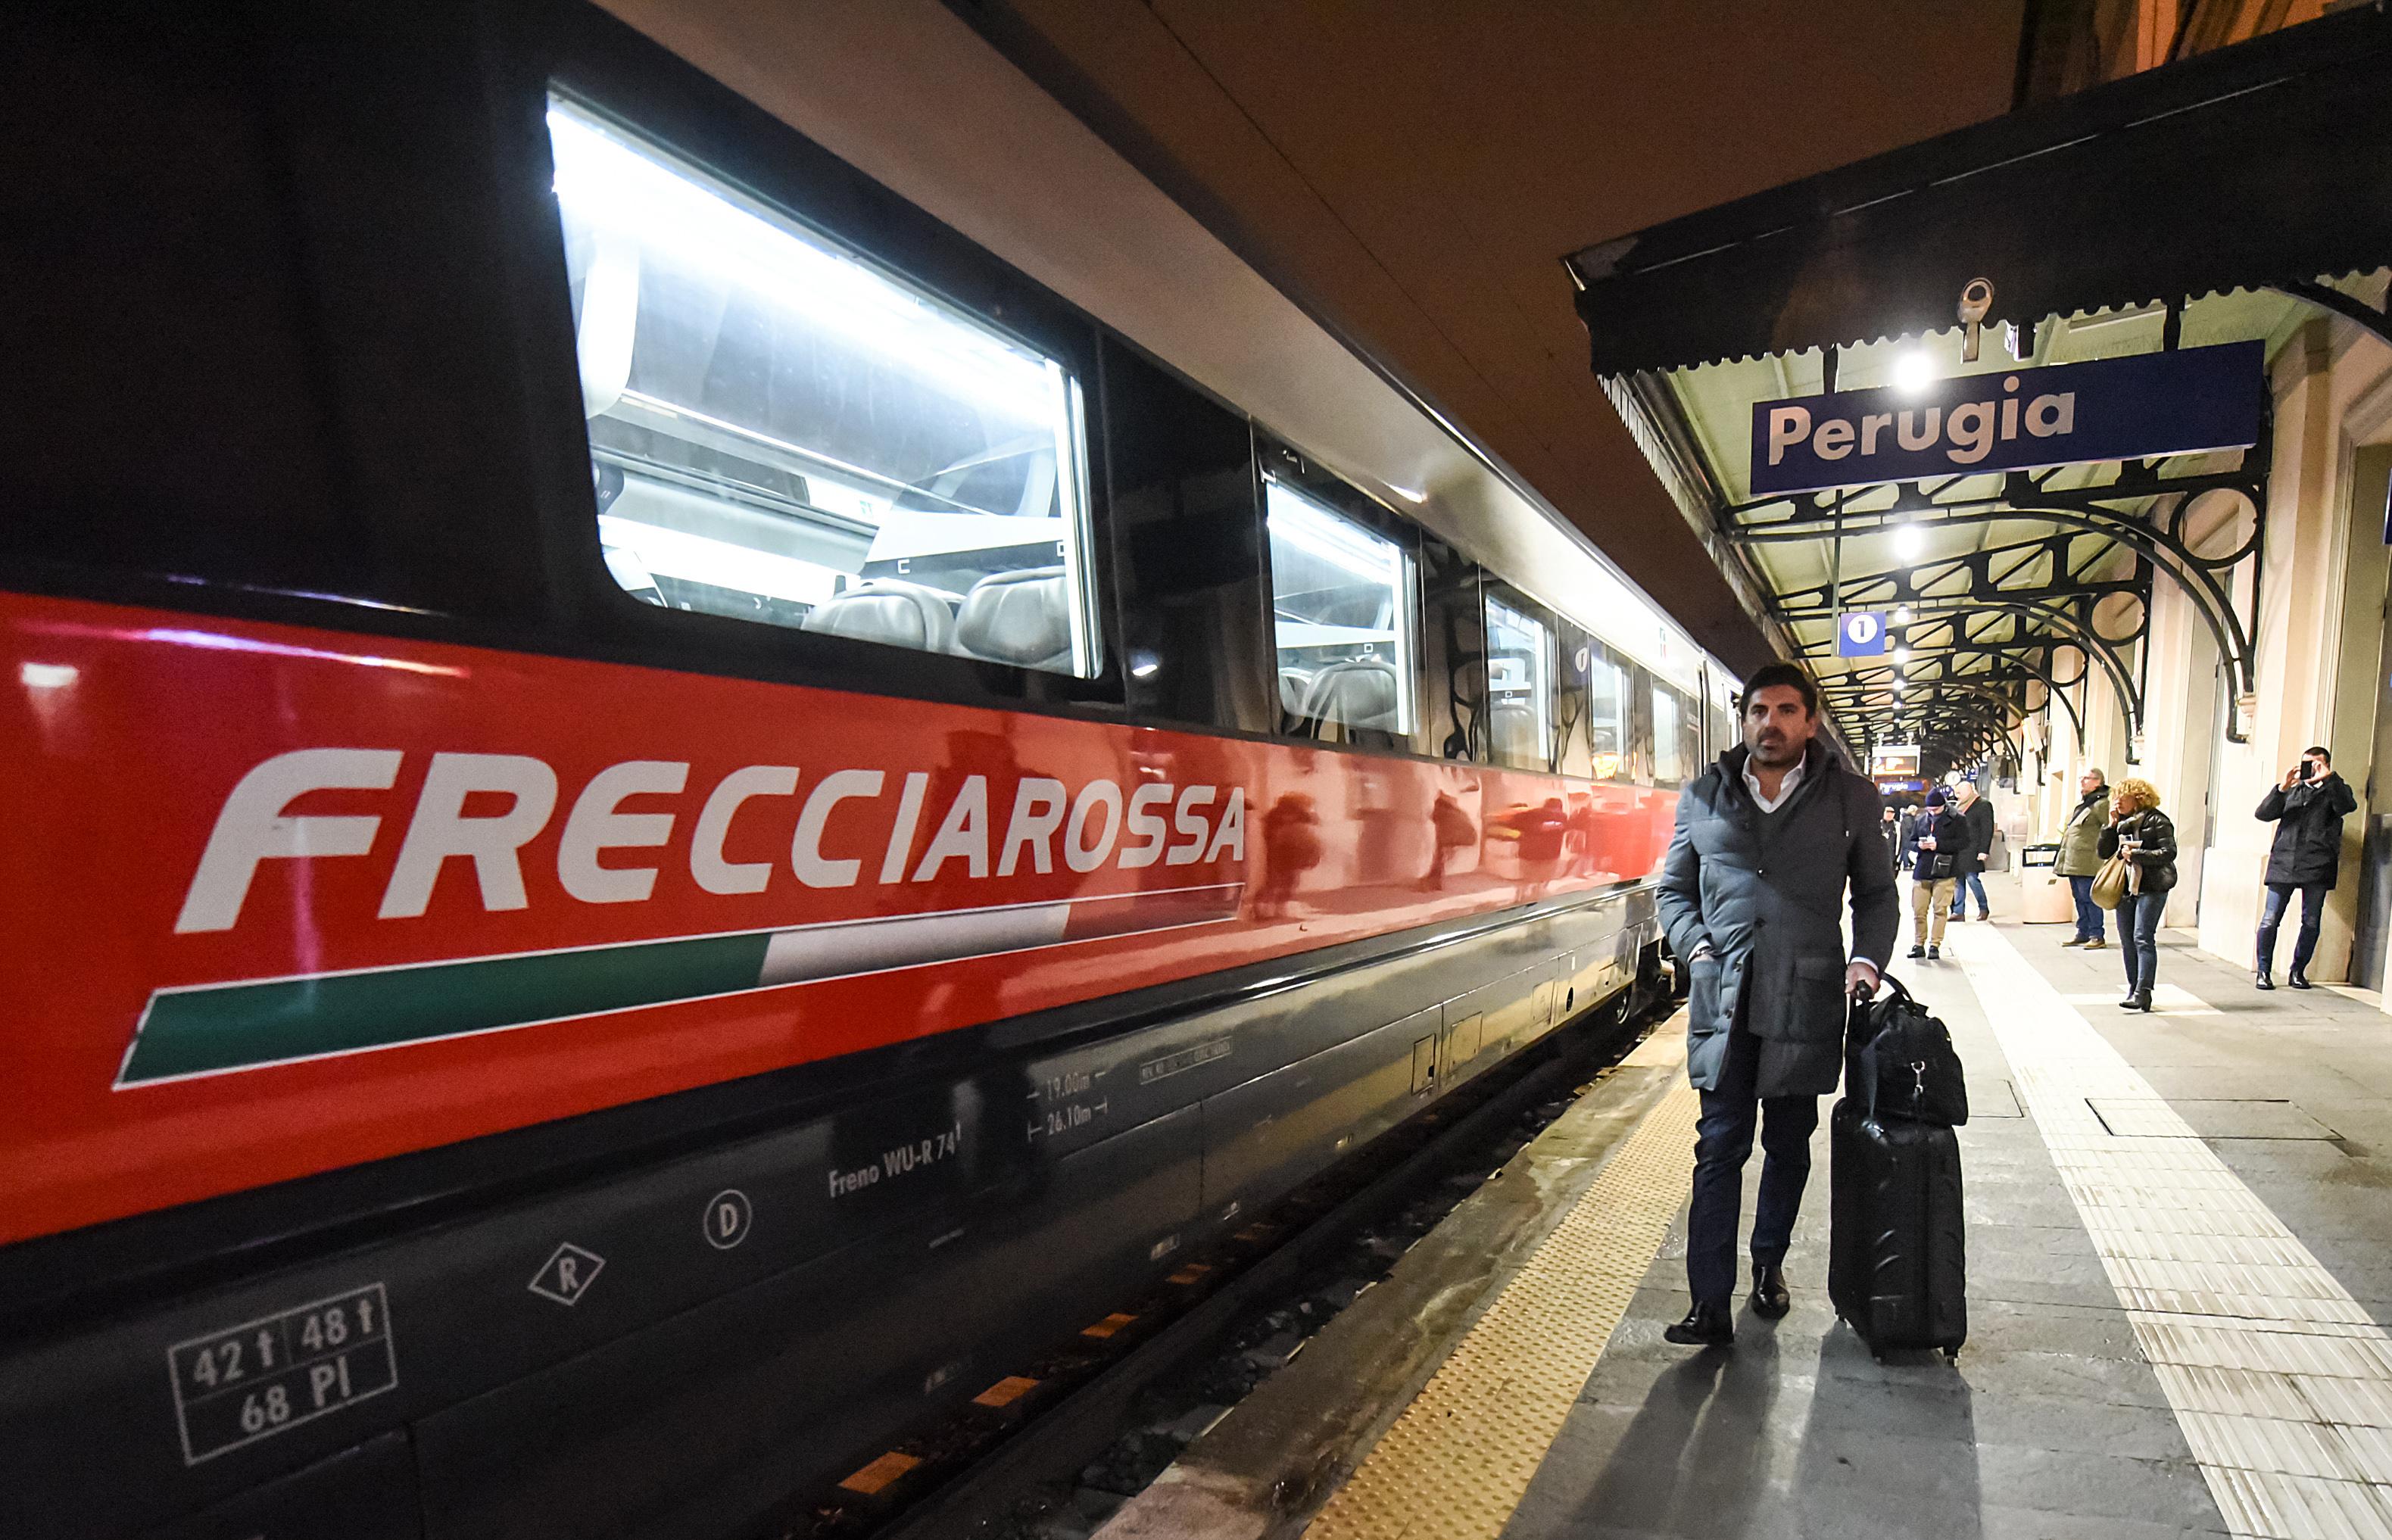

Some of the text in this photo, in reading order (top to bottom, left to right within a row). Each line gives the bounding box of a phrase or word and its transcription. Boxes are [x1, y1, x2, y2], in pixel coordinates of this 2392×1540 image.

[1769, 376, 2075, 465] Perugia
[1857, 620, 1865, 638] 1
[175, 748, 1244, 934] FRECCIAROSSA
[829, 1165, 880, 1198] Freno
[883, 1139, 933, 1177] WU-R
[720, 1203, 738, 1237] D
[558, 1257, 579, 1293] R
[303, 1308, 347, 1350] 48
[193, 1341, 244, 1386] 42
[241, 1385, 289, 1432] 68
